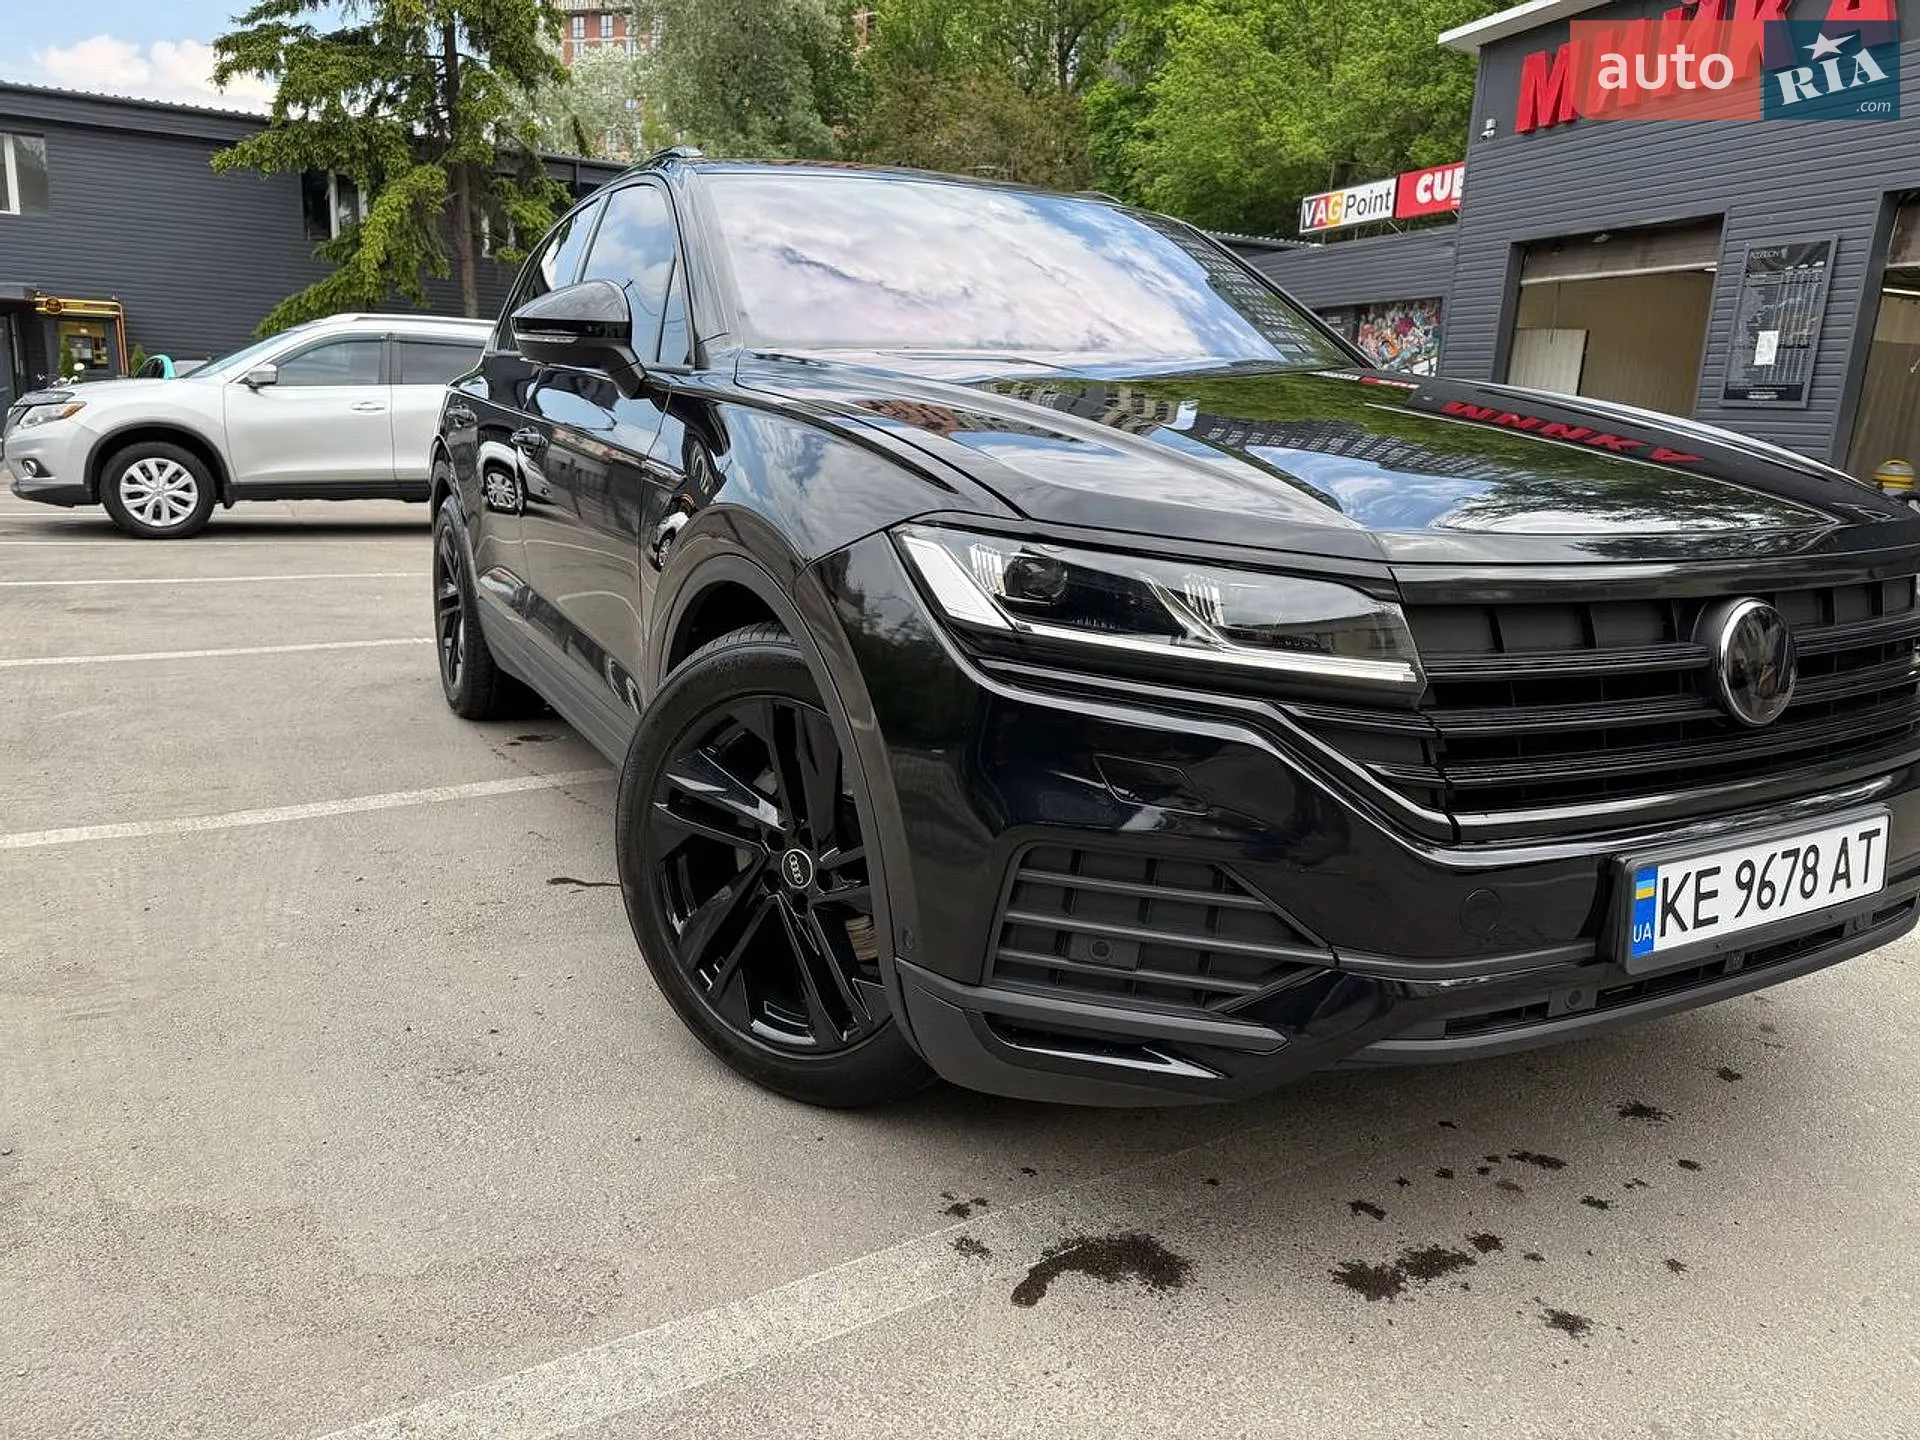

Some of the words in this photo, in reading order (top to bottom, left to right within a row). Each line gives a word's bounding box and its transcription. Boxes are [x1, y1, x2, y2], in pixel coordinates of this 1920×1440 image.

[1303, 194, 1343, 228] VAG
[1344, 187, 1392, 219] Point
[1659, 865, 1722, 938] KE
[1734, 844, 1820, 920] 9678
[1828, 827, 1882, 894] AT
[1632, 921, 1653, 943] UA
